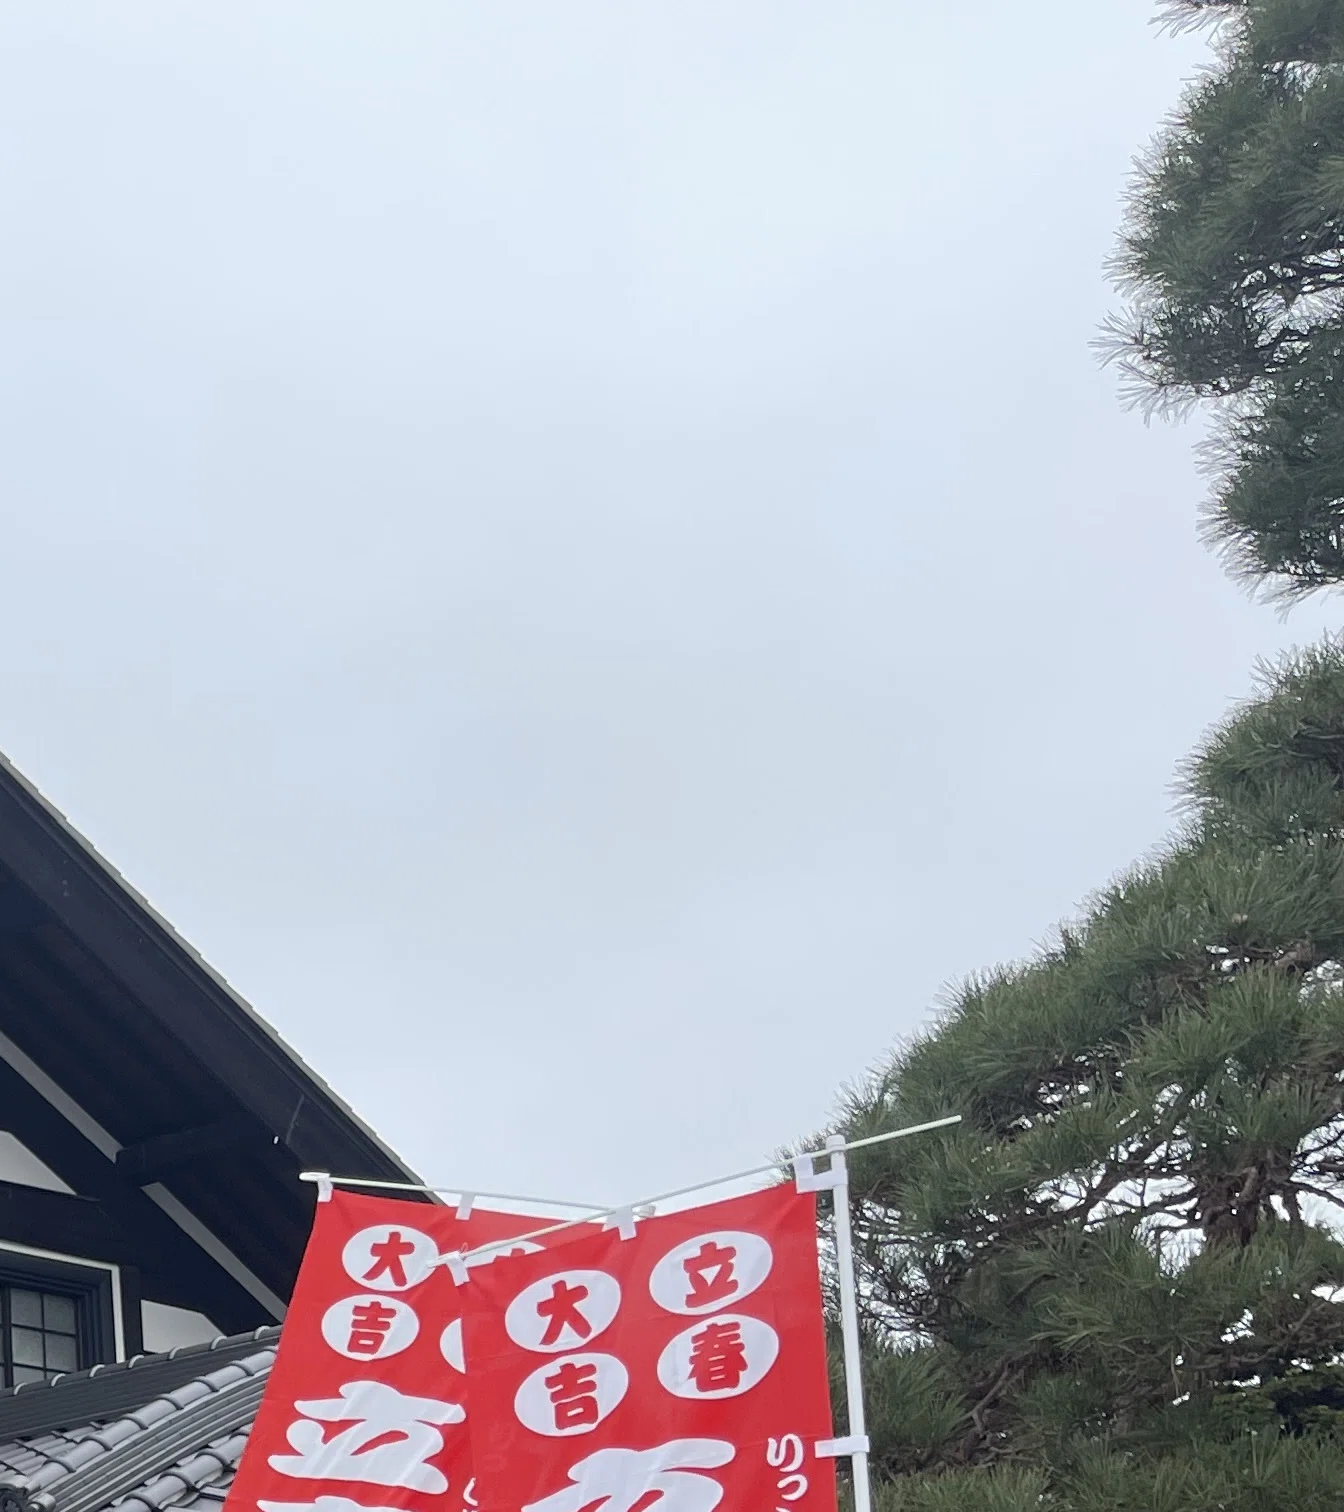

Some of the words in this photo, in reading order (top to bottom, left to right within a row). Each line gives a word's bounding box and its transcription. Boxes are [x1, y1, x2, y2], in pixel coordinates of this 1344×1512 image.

[348, 1231, 416, 1353] 大吉
[537, 1280, 600, 1430] 大吉
[683, 1241, 748, 1393] 立春
